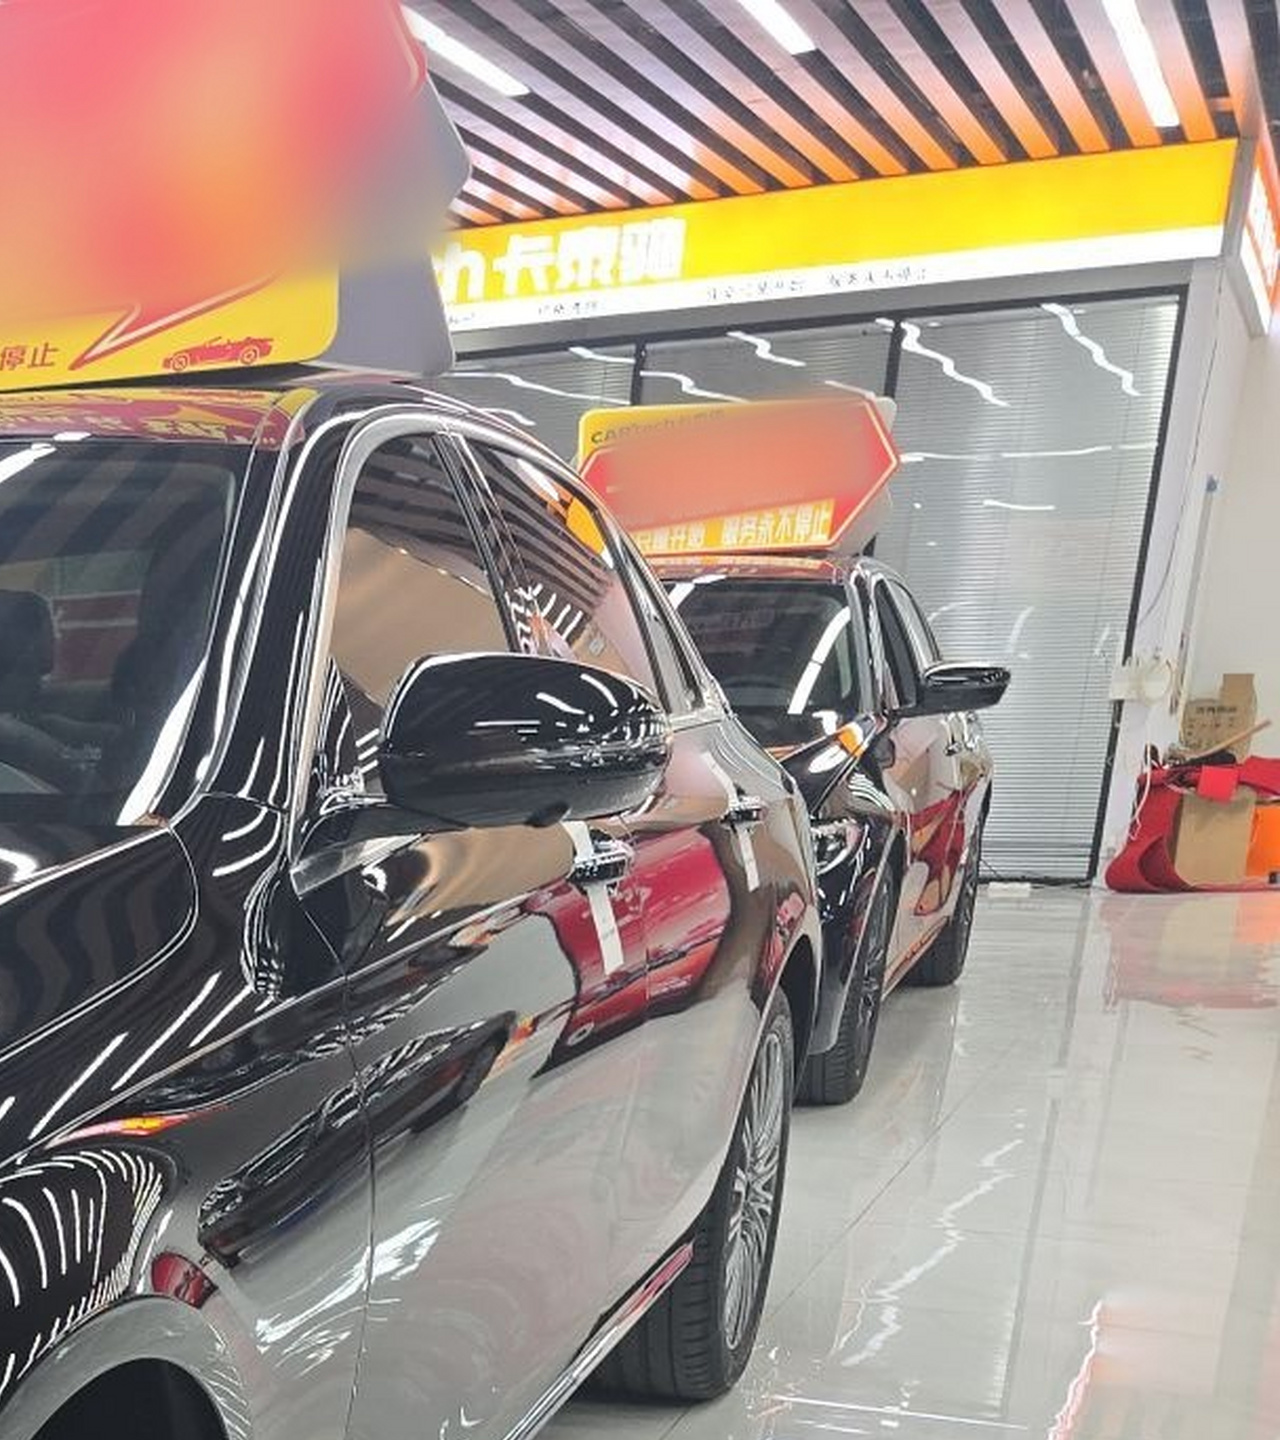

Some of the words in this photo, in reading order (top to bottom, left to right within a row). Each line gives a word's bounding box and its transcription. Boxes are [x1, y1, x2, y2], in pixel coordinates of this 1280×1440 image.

[721, 502, 831, 546] 服务永不停止
